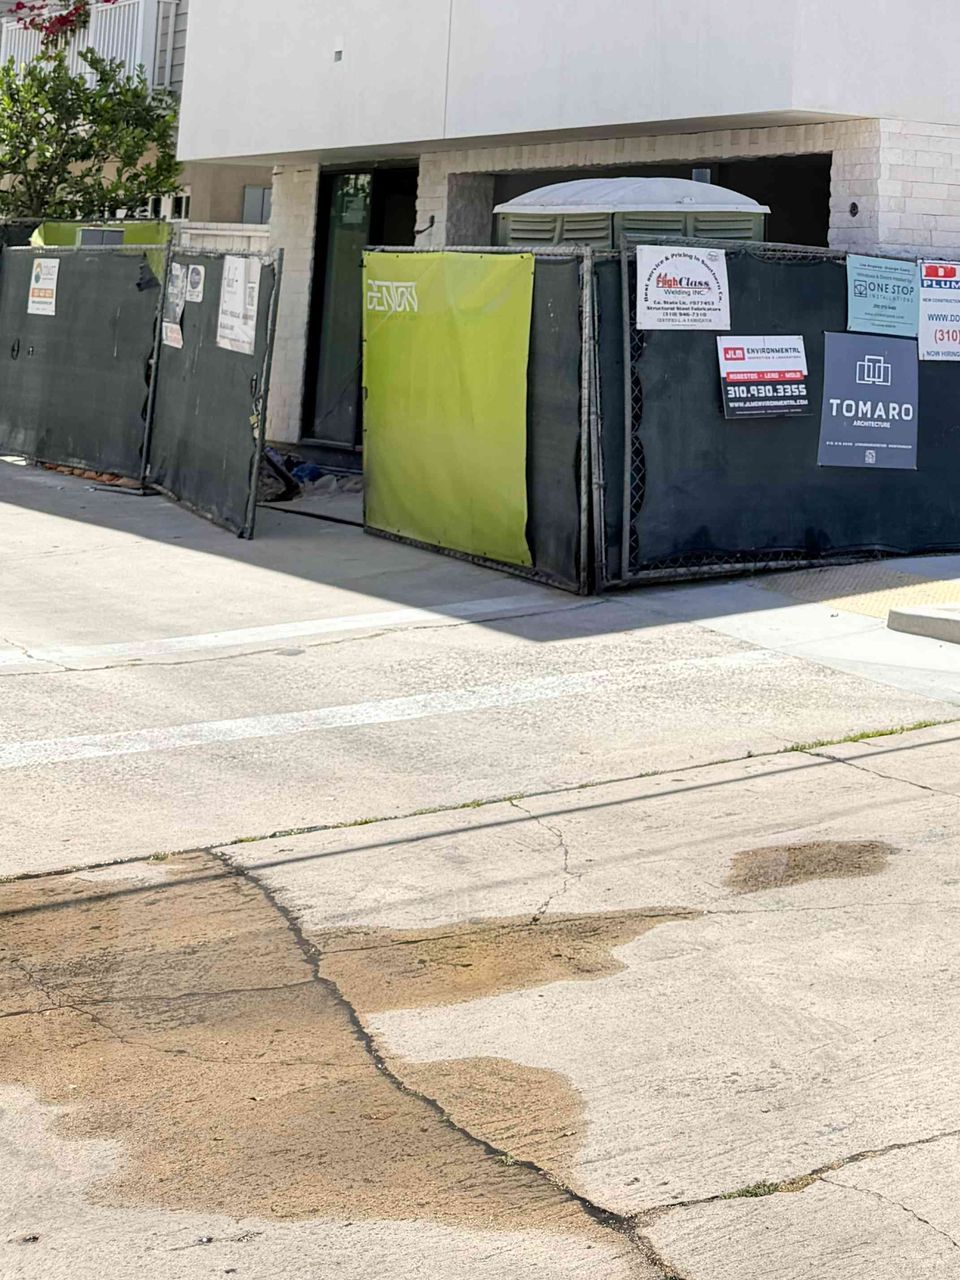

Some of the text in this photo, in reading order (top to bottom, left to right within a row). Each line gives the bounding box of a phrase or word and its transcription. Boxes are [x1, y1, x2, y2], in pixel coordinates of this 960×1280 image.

[868, 282, 914, 296] ONE STOP
[747, 347, 801, 355] ENVIRONMENTAL
[727, 384, 807, 398] 310.930.3355
[829, 398, 913, 421] TOMARO
[853, 420, 891, 428] ARCHITECTURE
